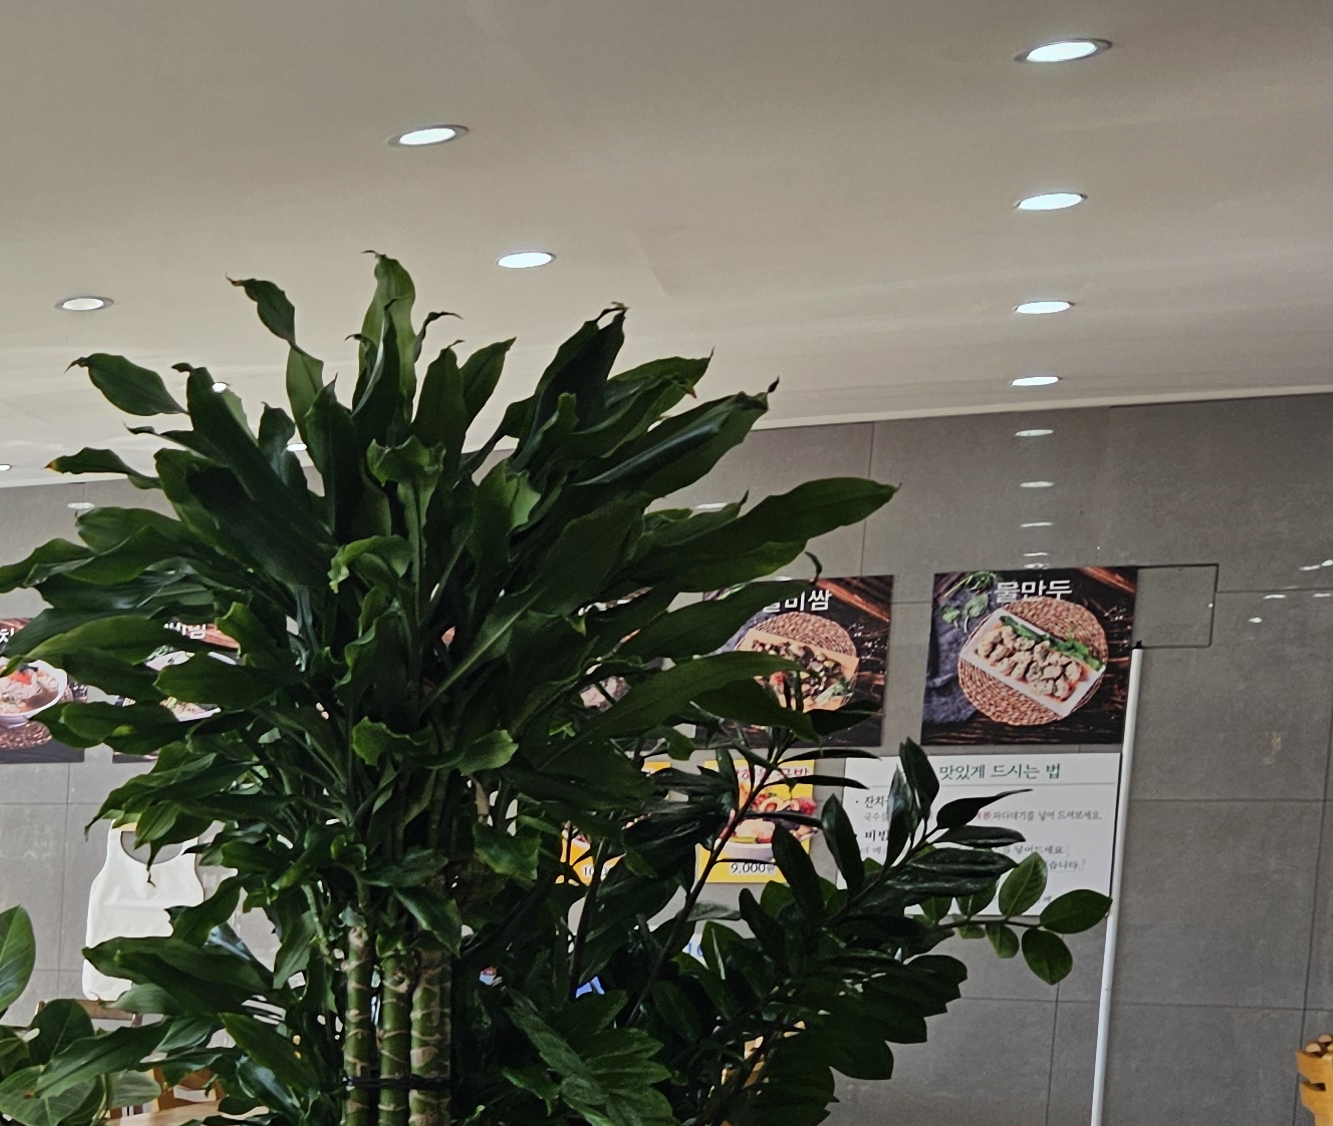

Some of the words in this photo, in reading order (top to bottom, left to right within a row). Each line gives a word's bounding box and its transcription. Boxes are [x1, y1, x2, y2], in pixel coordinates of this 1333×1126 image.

[993, 579, 1073, 604] 물만두
[939, 763, 986, 781] 맛있게
[990, 764, 1040, 780] 드시는
[1045, 763, 1061, 779] 법
[864, 795, 889, 809] 잔치
